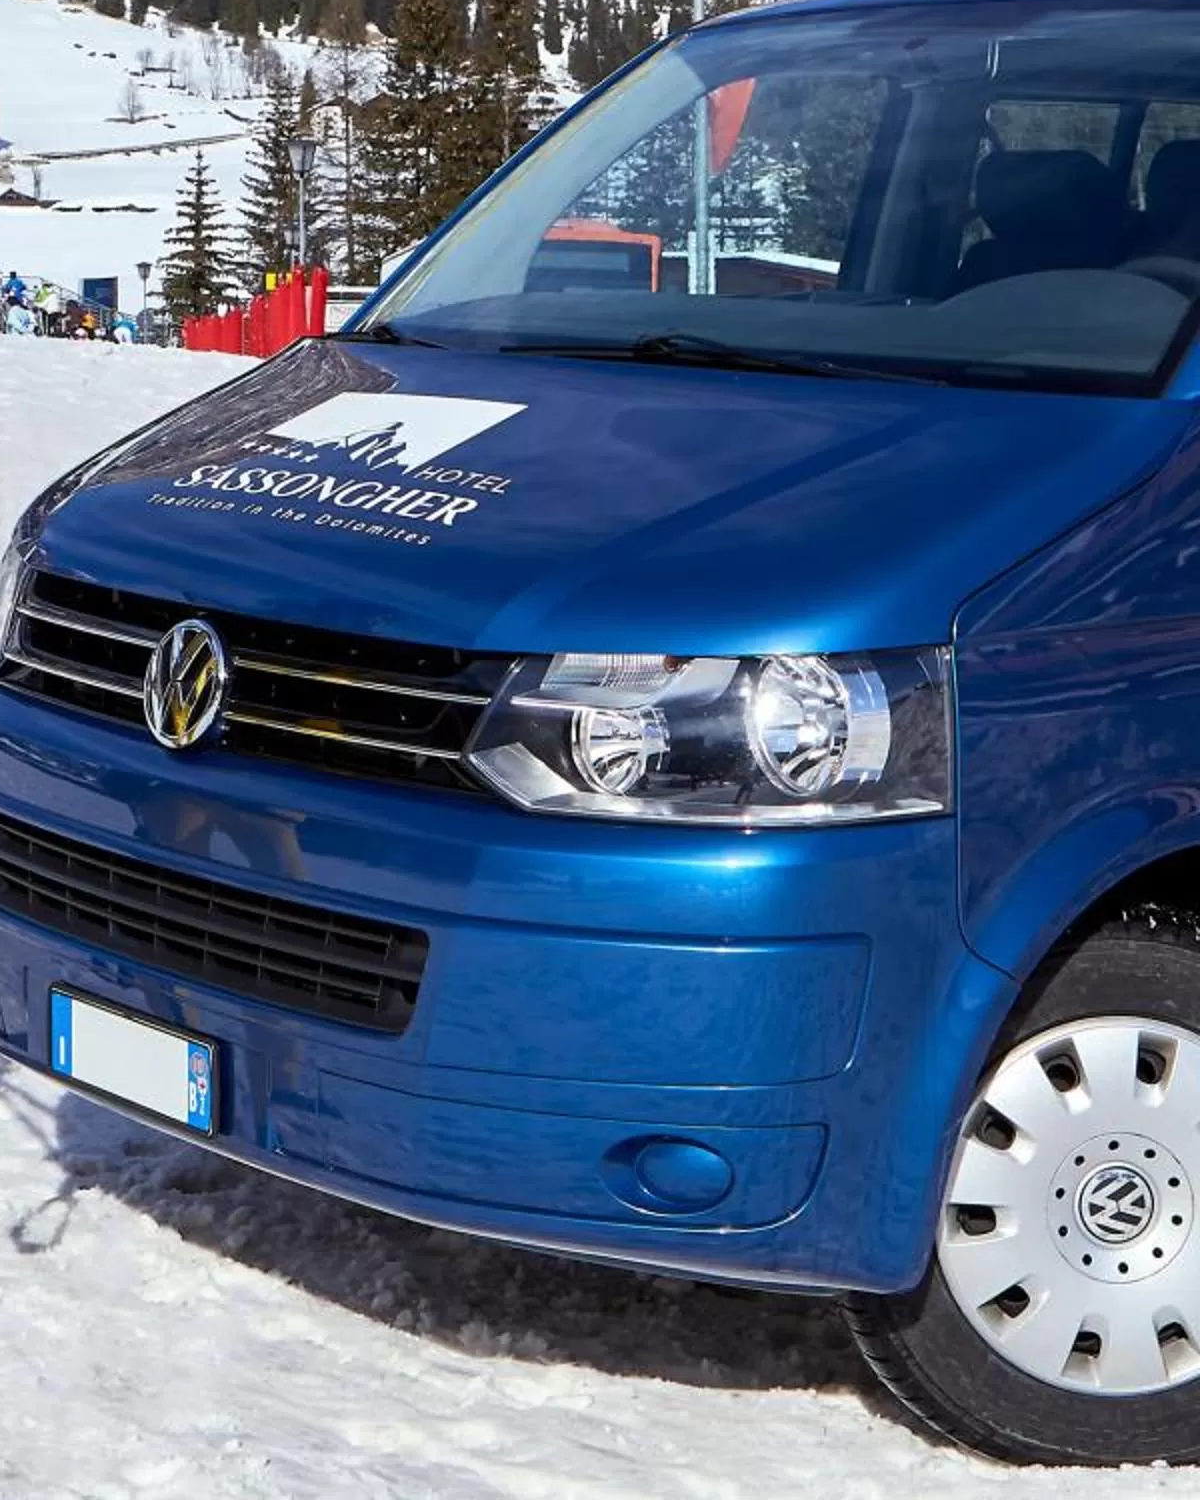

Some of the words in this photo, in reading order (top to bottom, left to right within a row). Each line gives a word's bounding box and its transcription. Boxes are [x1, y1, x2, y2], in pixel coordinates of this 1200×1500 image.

[173, 464, 479, 526] SASSONGHER
[413, 465, 512, 494] HOTEL
[147, 493, 235, 511] Tradition
[241, 503, 263, 514] in
[271, 506, 307, 522] the
[314, 512, 431, 546] Dolomites
